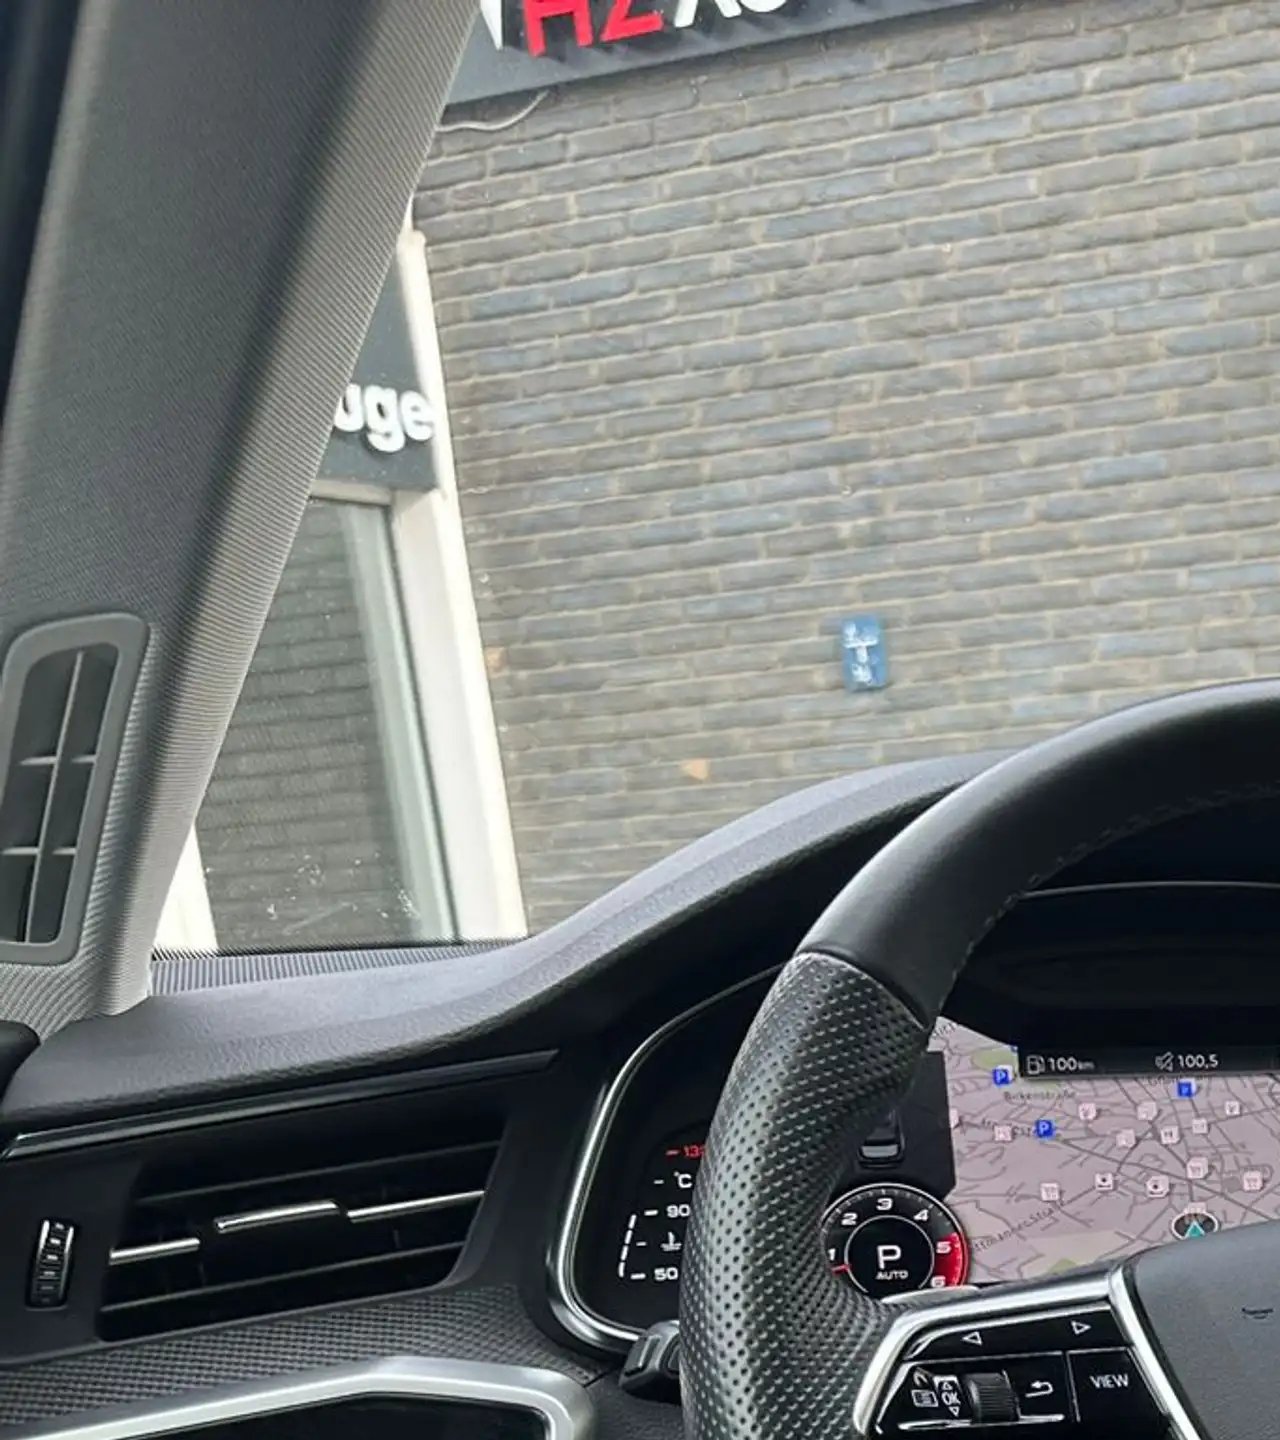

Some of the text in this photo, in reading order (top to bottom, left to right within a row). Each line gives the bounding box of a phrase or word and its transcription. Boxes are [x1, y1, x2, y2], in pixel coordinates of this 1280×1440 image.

[666, 1204, 690, 1218] 90
[876, 1198, 893, 1211] 3
[841, 1212, 858, 1226] 2
[913, 1209, 929, 1221] 4
[828, 1248, 837, 1261] 1
[936, 1241, 952, 1254] 5
[876, 1244, 902, 1270] P
[654, 1267, 679, 1281] 50
[876, 1269, 909, 1280] AUTO
[1089, 1373, 1130, 1389] VIEW
[941, 1391, 962, 1406] OK
